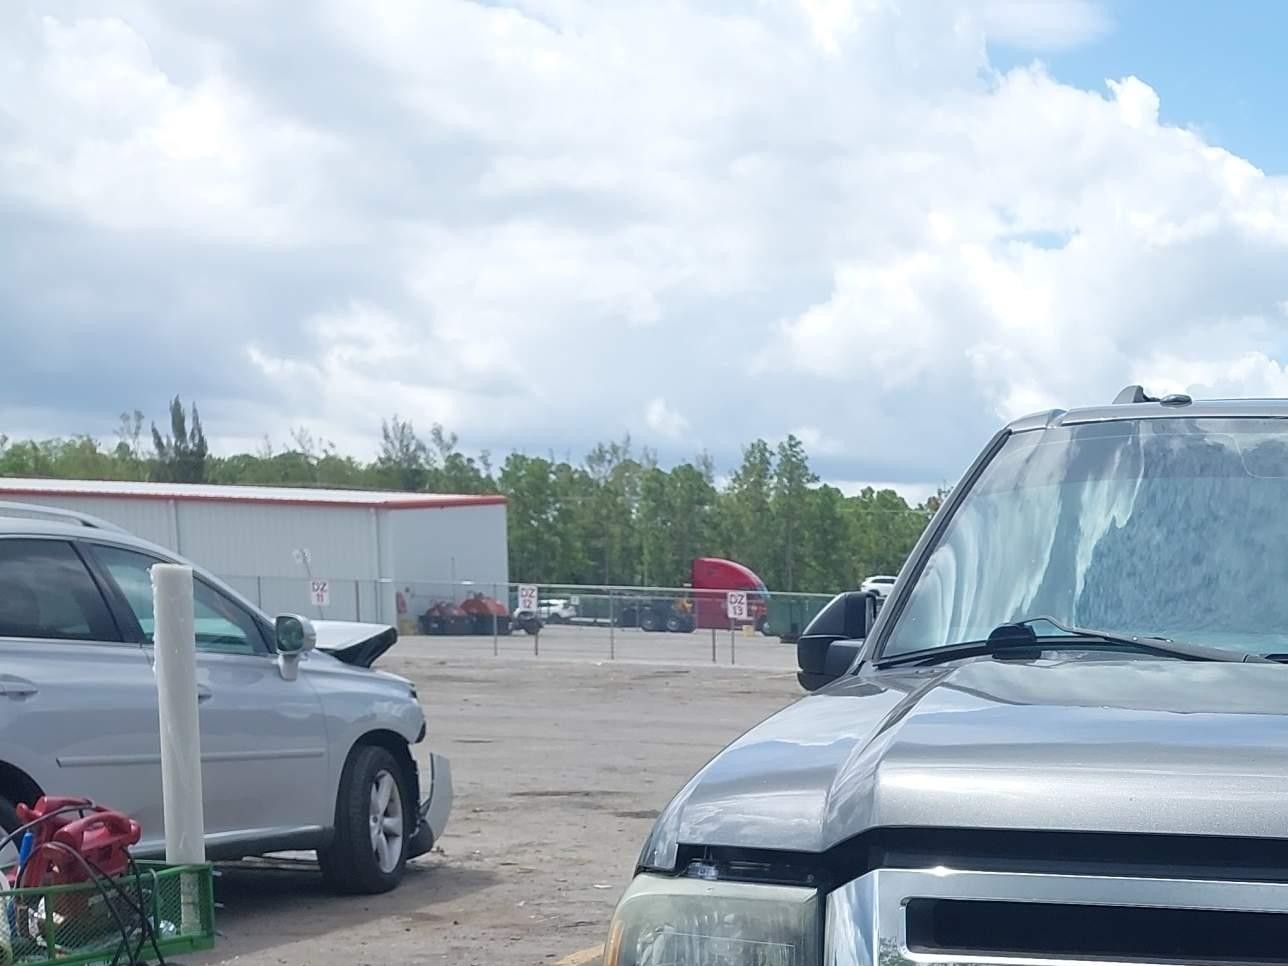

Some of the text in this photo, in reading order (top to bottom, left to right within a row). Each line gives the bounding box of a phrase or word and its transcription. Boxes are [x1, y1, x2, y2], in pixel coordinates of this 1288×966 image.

[311, 582, 328, 593] DZ
[521, 587, 536, 598] DZ
[729, 594, 745, 605] DZ
[732, 605, 743, 616] 13
